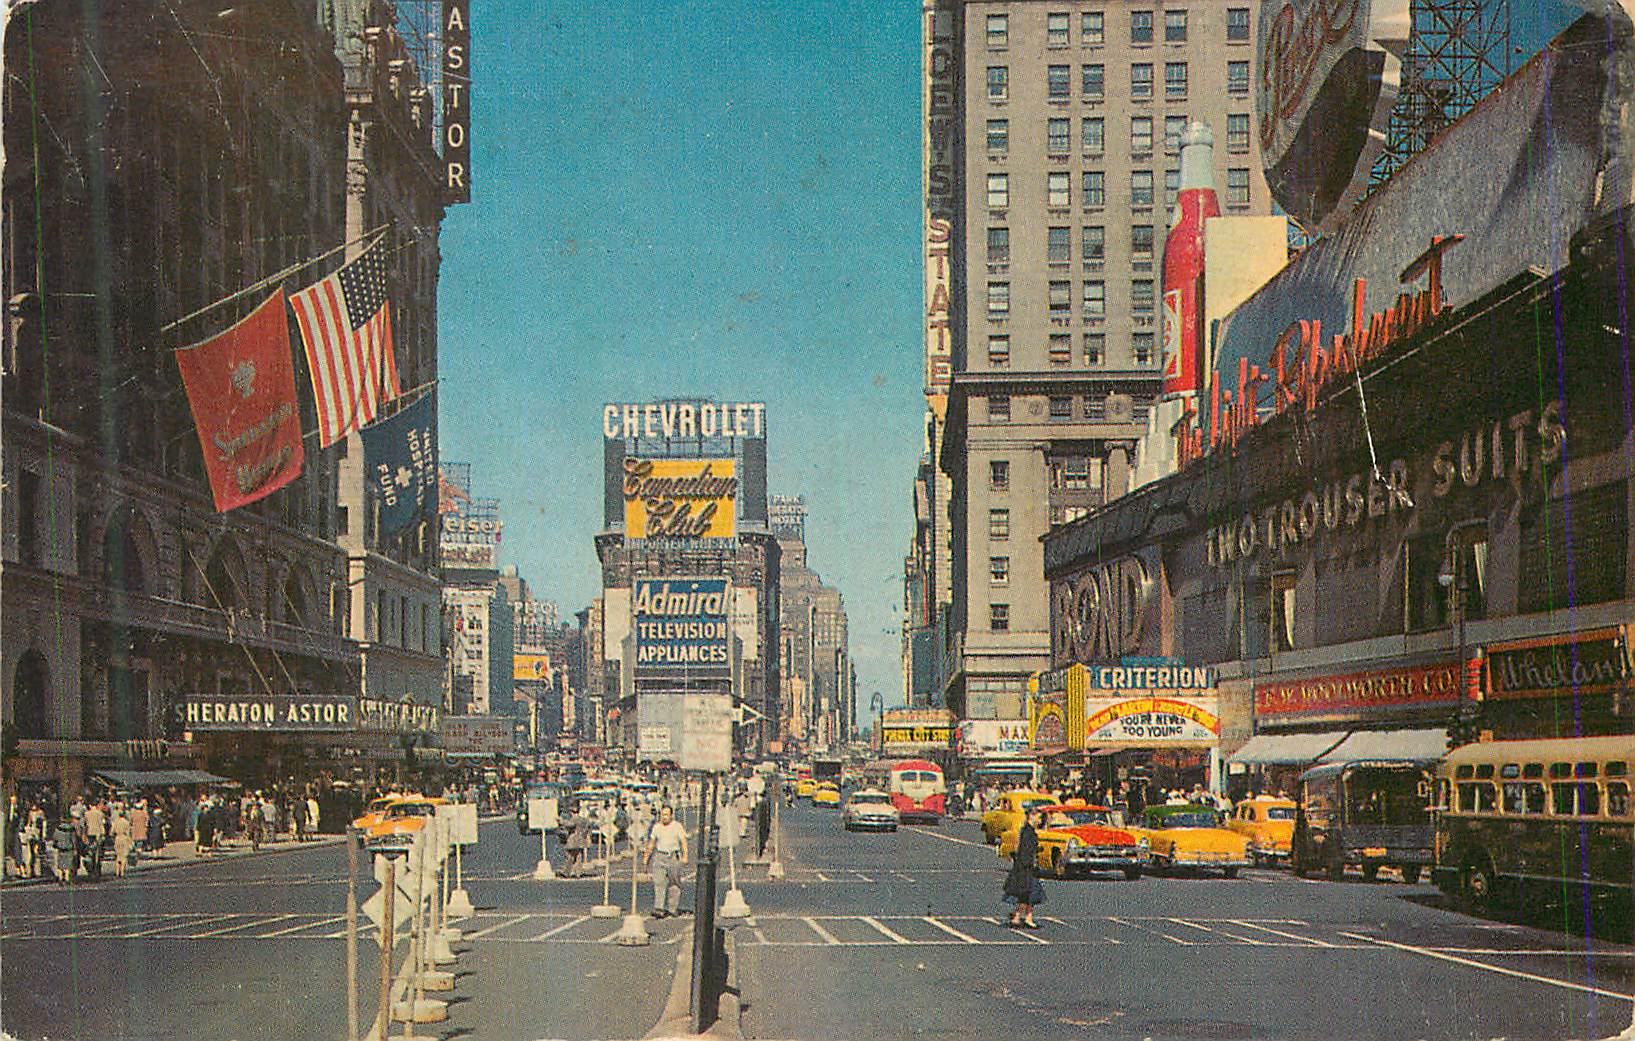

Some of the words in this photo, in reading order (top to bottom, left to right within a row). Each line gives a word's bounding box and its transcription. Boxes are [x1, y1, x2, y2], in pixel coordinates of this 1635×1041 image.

[447, 6, 464, 188] ASTOR
[928, 217, 951, 388] STATE
[603, 403, 765, 438] CHEVROLET
[378, 463, 397, 506] FUND
[623, 456, 738, 500] Canadian
[1264, 459, 1408, 549] TROUSER
[1432, 401, 1567, 497] SUITS
[646, 498, 719, 541] Club
[634, 582, 731, 616] Admiral
[639, 622, 727, 640] TELEVISION
[638, 645, 728, 662] APPLIANCES
[1100, 667, 1207, 689] CRITERION
[175, 702, 275, 722] SHERATON
[287, 702, 349, 722] ASTOR
[1156, 714, 1187, 726] NEVER
[1123, 727, 1144, 737] TOO
[1147, 726, 1183, 738] YOUNG
